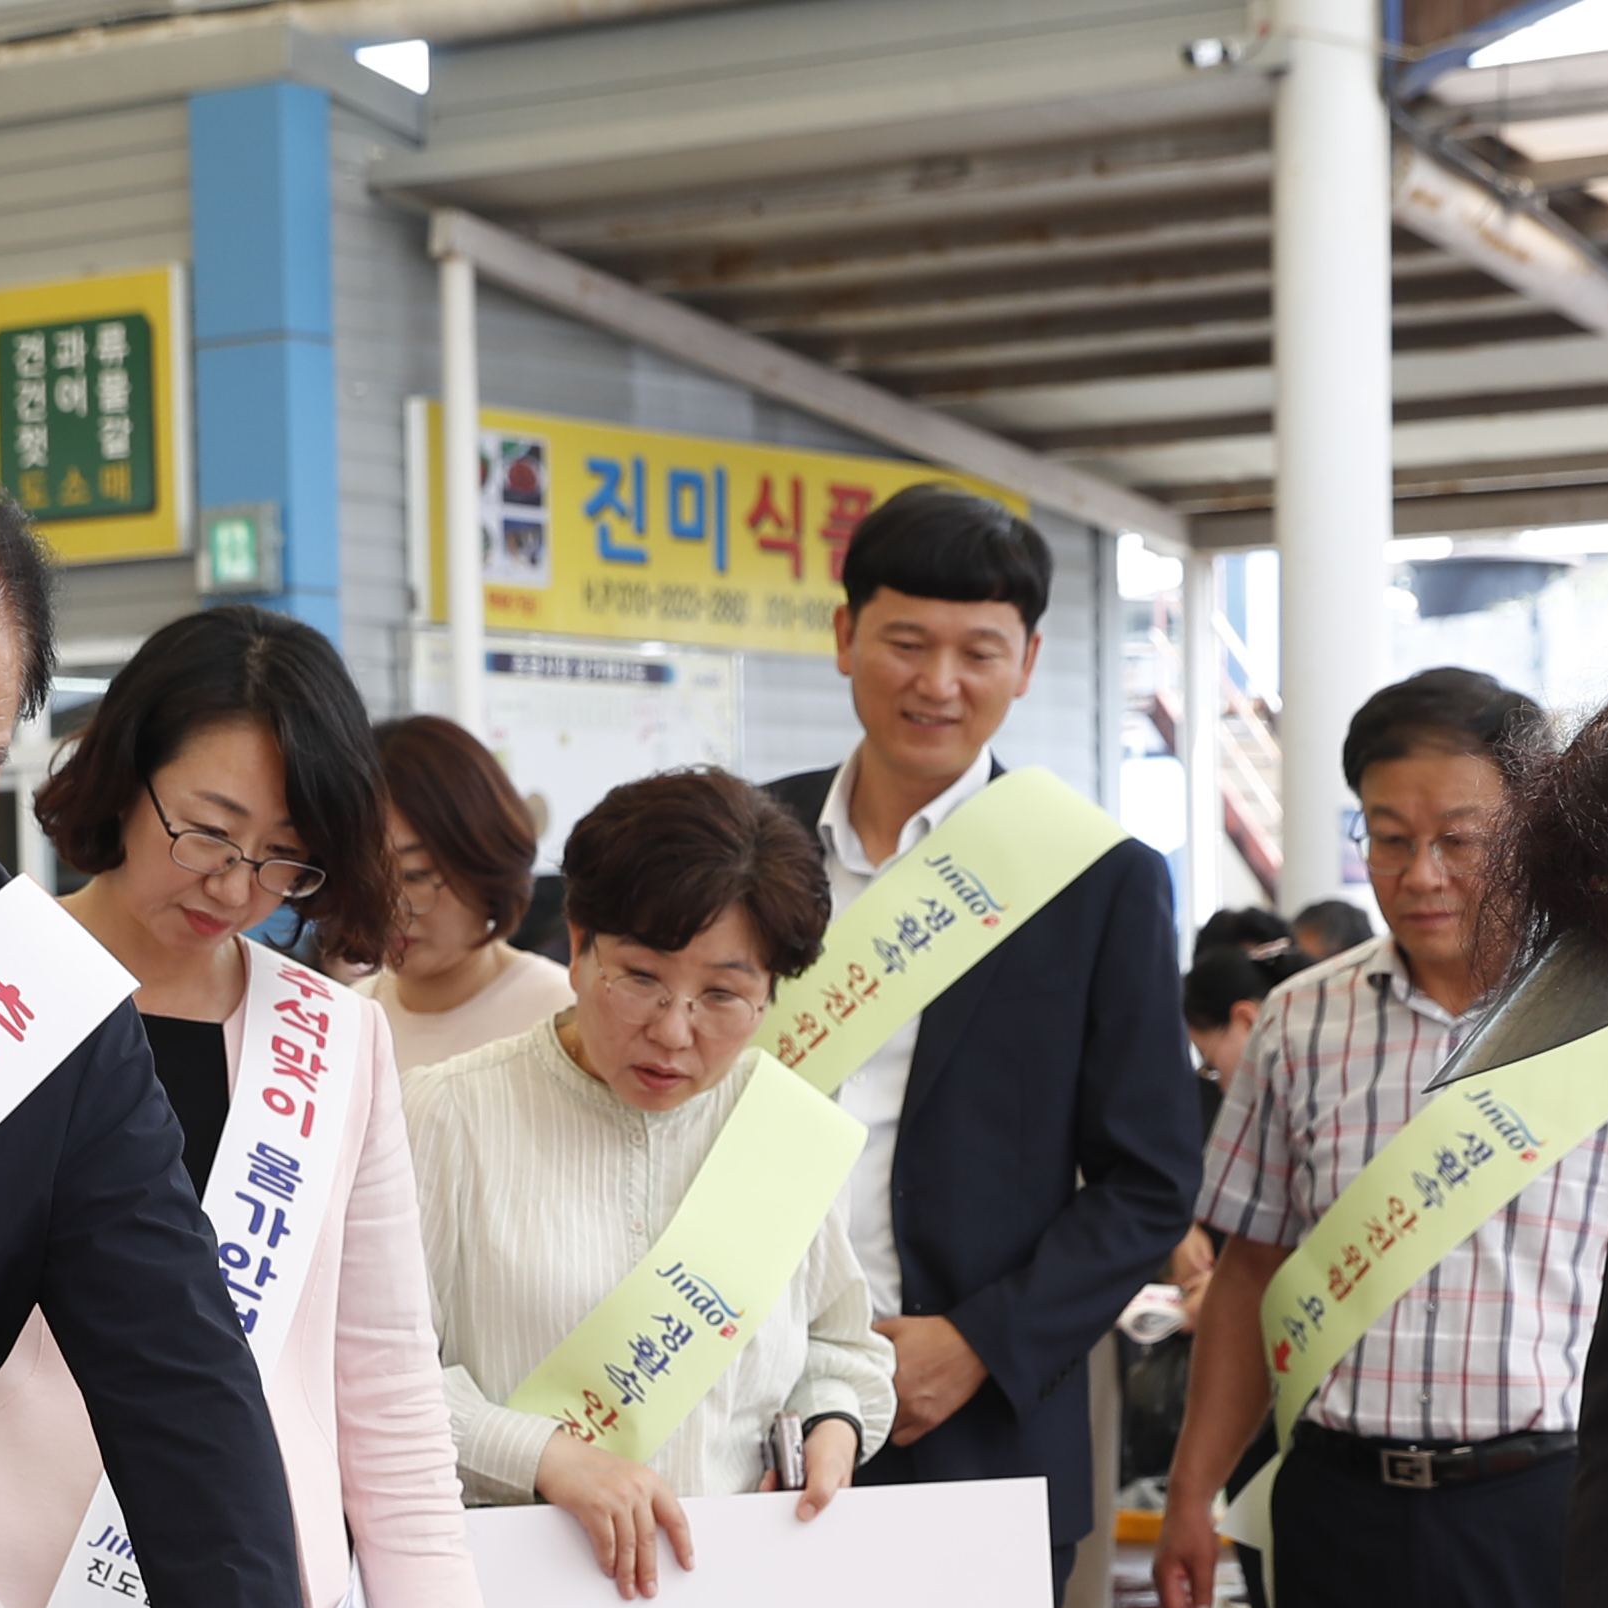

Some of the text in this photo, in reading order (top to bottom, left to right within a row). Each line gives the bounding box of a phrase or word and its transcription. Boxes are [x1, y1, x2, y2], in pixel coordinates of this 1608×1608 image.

[924, 854, 990, 918] Jindo
[870, 896, 957, 975] 생활속
[262, 962, 335, 1139] 추석맞이
[1464, 1088, 1527, 1152] Jindo
[1412, 1130, 1495, 1209] 생활속
[655, 1261, 725, 1327] Jindo
[603, 1313, 694, 1406] 생활속
[87, 1525, 136, 1560] Jin
[87, 1557, 151, 1607] 진도
